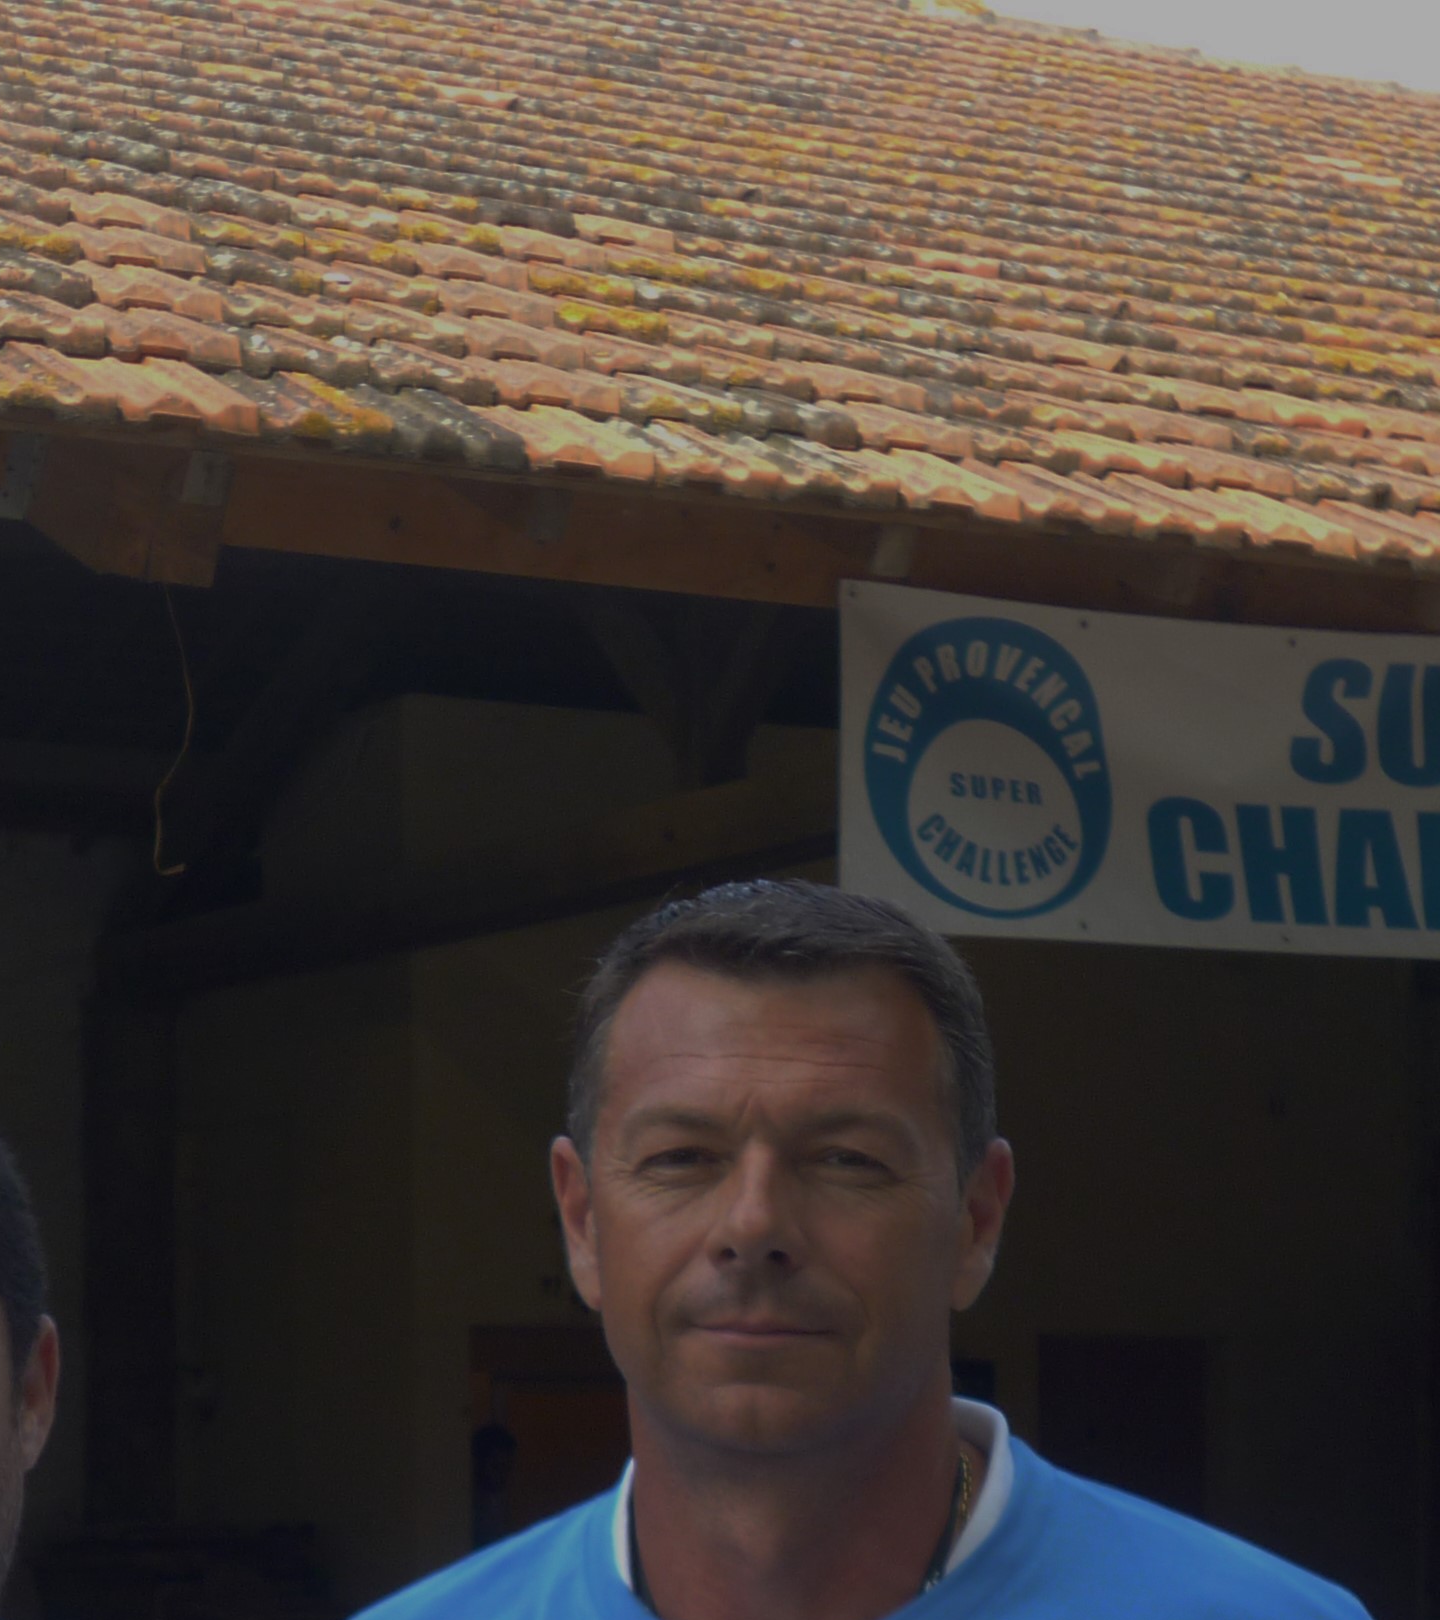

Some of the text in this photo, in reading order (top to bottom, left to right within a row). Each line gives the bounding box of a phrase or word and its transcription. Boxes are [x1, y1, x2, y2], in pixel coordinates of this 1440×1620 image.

[871, 640, 1103, 780] JEU PROVENCAL
[949, 772, 1043, 805] SUPER
[916, 813, 1080, 887] CHALLENGE
